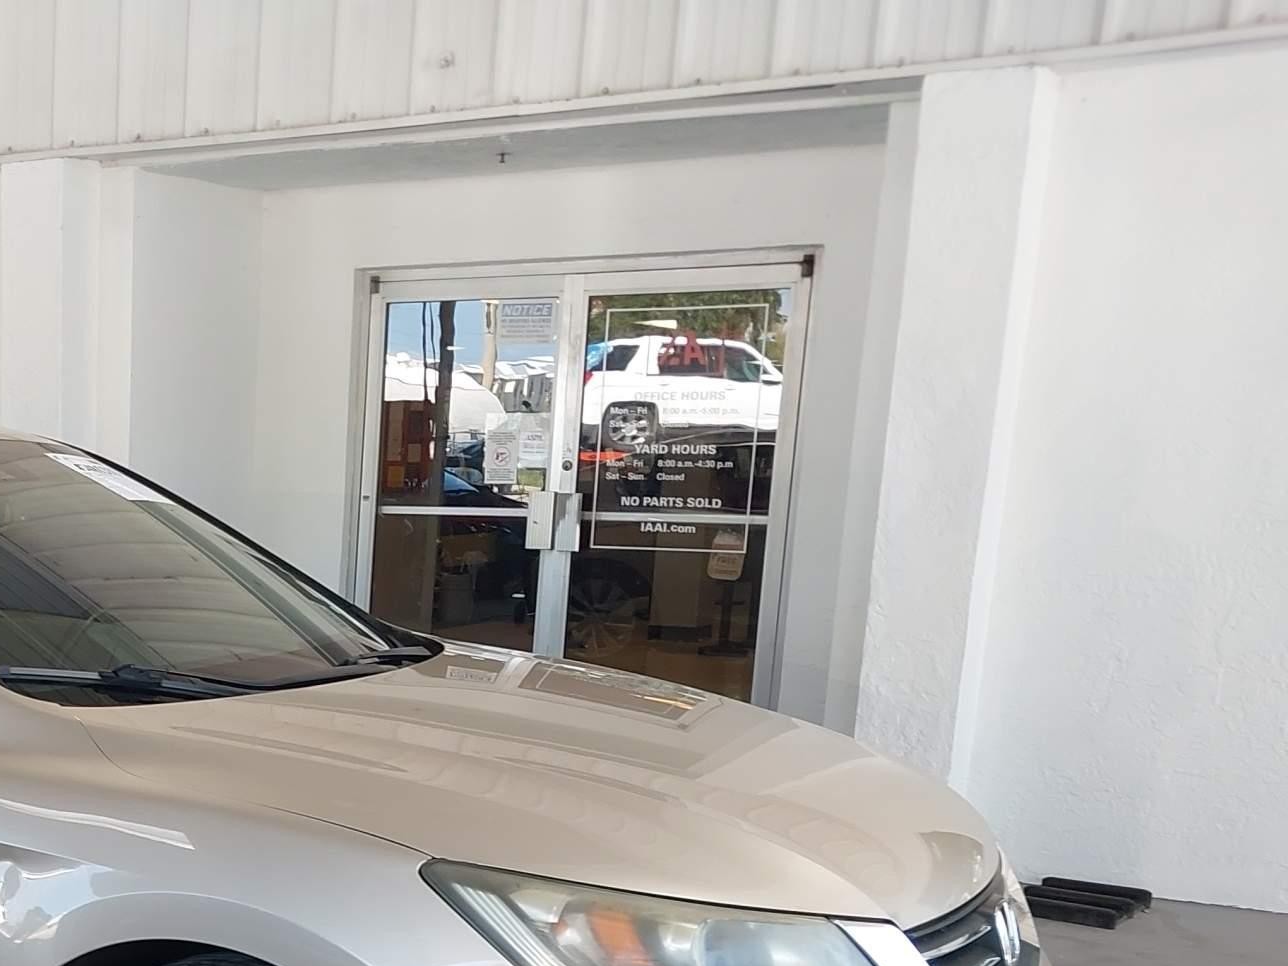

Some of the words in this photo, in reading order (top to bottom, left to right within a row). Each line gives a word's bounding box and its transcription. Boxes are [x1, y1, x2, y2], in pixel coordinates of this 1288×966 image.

[503, 304, 551, 316] NOTICE
[633, 391, 678, 401] OFFICE
[681, 391, 726, 401] HOURS
[609, 406, 629, 415] Mon
[637, 406, 648, 415] Fri
[634, 445, 668, 454] YARD
[671, 445, 717, 455] HOURS
[633, 459, 644, 467] Fri
[657, 459, 675, 467] 8:00
[605, 472, 620, 480] Sat
[656, 472, 685, 481] Closed
[620, 496, 640, 506] NO
[642, 497, 684, 507] PARTS
[686, 497, 722, 509] SOLD
[640, 522, 697, 533] IAAI.com
